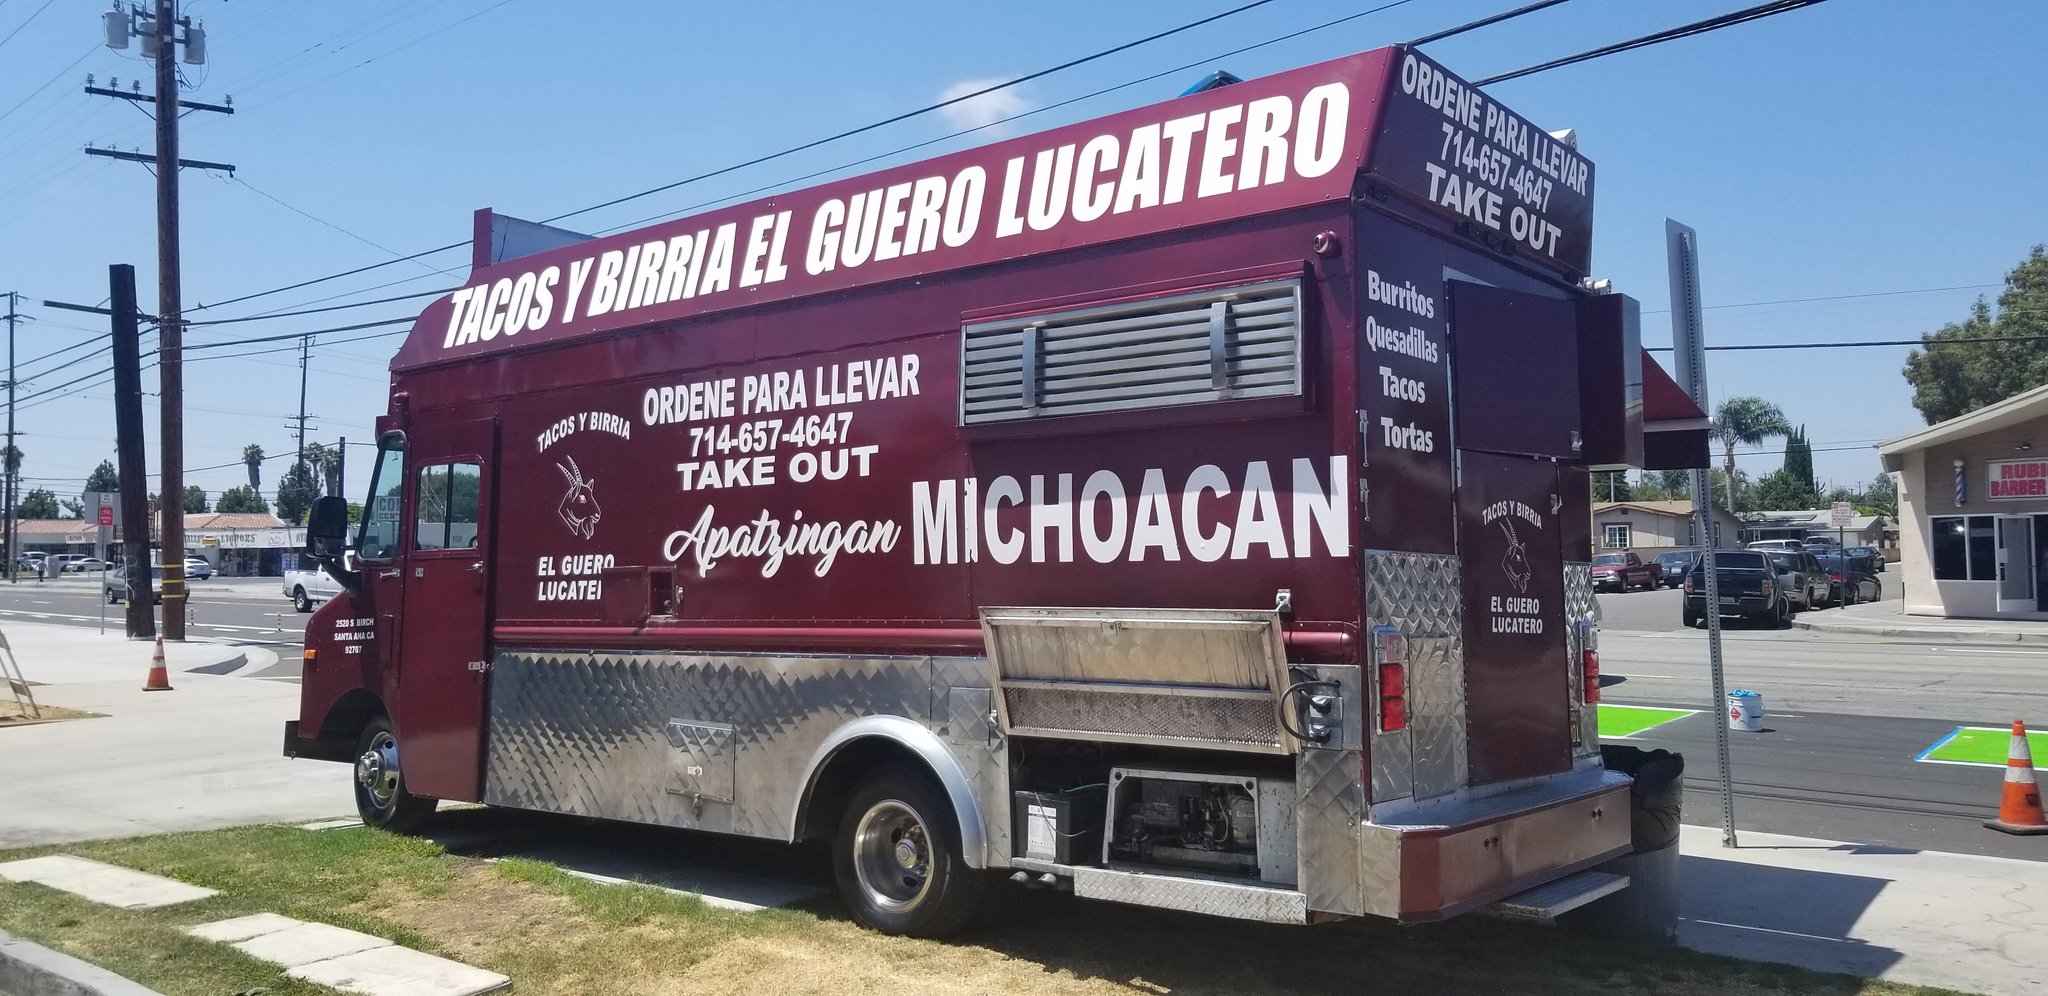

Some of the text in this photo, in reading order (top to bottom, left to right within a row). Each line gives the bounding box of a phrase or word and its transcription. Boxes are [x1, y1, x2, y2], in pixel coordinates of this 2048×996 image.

[1401, 54, 1588, 196] ORDENE PARA LLEVAR
[1441, 121, 1553, 214] 714-657-4647
[443, 81, 1350, 348] TACOS Y BIRRIA EL GUERO LUCATERO
[1426, 162, 1561, 258] TAKE OUT
[1367, 269, 1434, 319] Burritos
[1366, 315, 1438, 364] Quesadillas
[643, 353, 920, 426] ORDENE PARA LLEVAR
[1379, 365, 1426, 404] Tacos
[537, 411, 631, 453] TACOS Y BIRRIA
[690, 411, 854, 457] 714-657-4647
[1380, 416, 1433, 453] Tortas
[677, 445, 879, 491] TAKE OUT
[1991, 479, 2047, 496] BARBER
[2001, 463, 2048, 479] RUBI
[912, 455, 1349, 565] MICHOACAN
[1482, 500, 1542, 529] TACOS Y BIRRIA
[663, 504, 902, 578] Apatzingan
[538, 556, 556, 576] EL
[538, 580, 602, 601] LUCATE
[1491, 596, 1540, 614] EL GUERO
[336, 618, 374, 627] 2520 S BIRCH
[353, 632, 365, 640] ANA
[1492, 617, 1543, 634] LUCATERO
[345, 646, 362, 654] 92707
